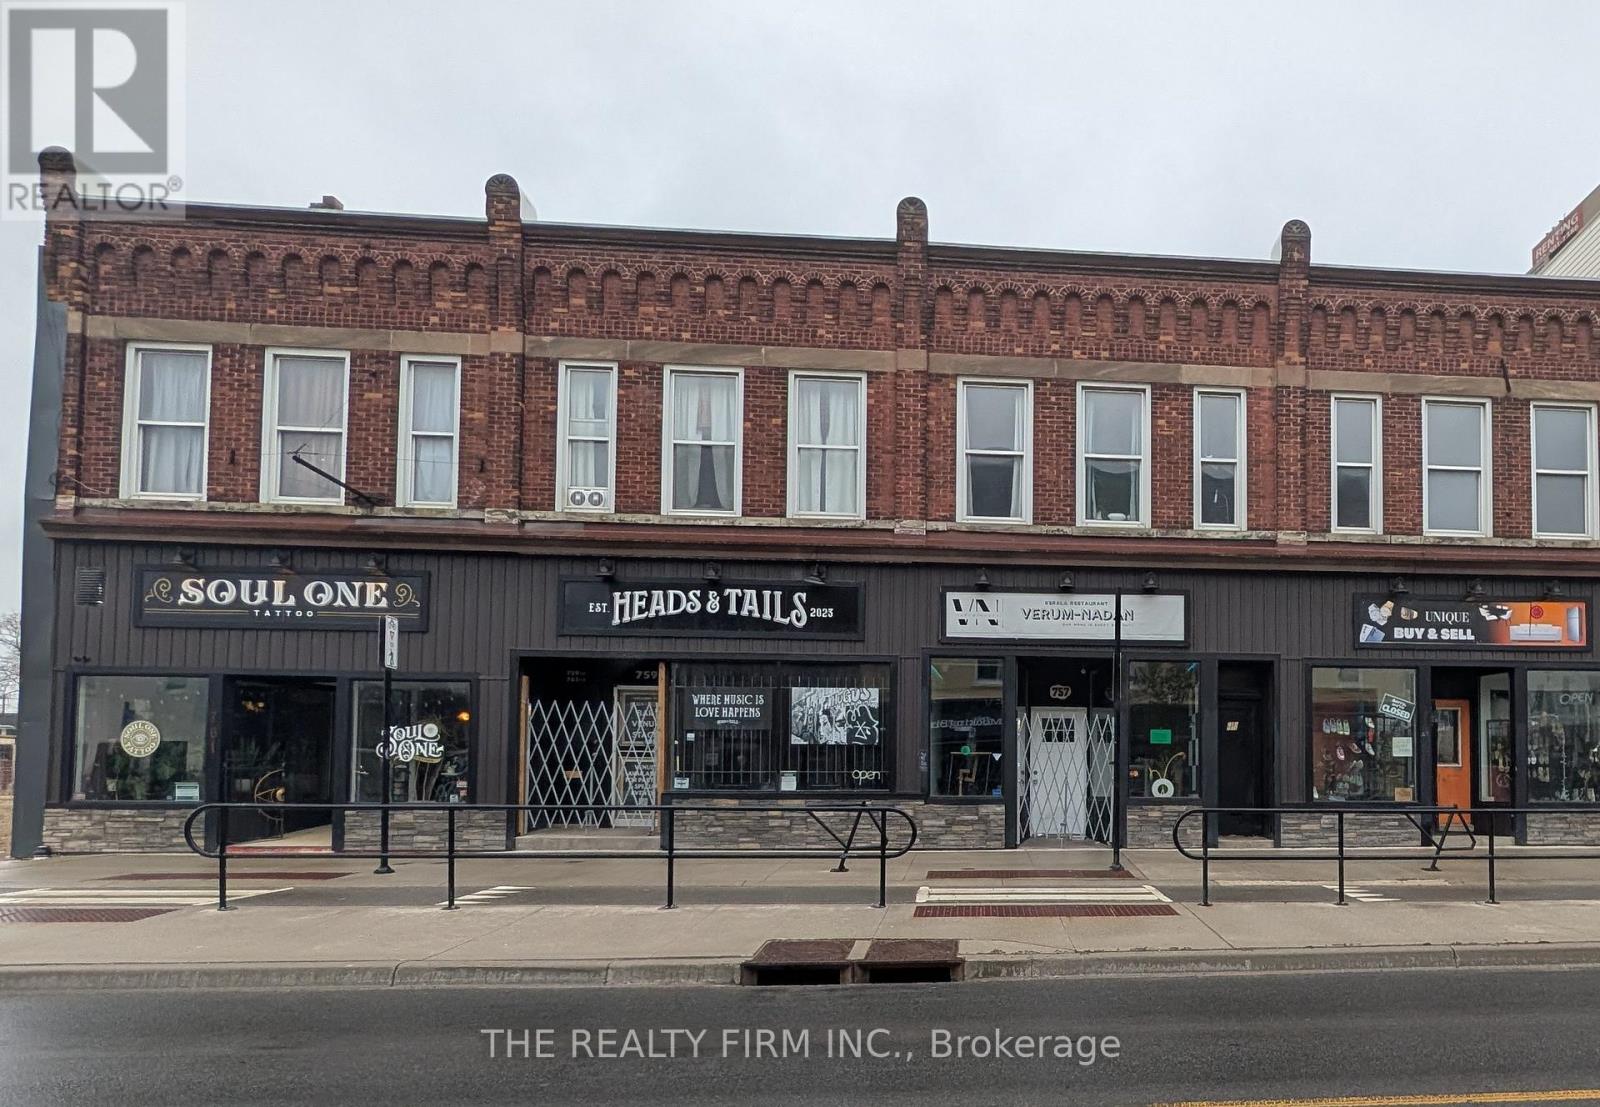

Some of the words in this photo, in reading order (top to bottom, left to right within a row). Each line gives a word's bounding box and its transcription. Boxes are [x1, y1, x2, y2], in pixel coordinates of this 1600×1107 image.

[178, 578, 296, 606] SOUL
[303, 580, 388, 608] ONE
[254, 609, 314, 618] TATTOO
[588, 602, 611, 614] EST.
[611, 588, 701, 626] HEADS
[705, 591, 720, 614] &
[724, 588, 807, 628] TAILS
[810, 607, 834, 618] 2023
[1425, 611, 1470, 626] UNIQUE
[1394, 627, 1424, 640] BUY
[1427, 627, 1438, 640] &
[1441, 628, 1475, 641] SELL
[634, 670, 657, 679] 759
[1052, 687, 1070, 697] 757
[1560, 692, 1594, 705] OPEN
[692, 694, 722, 706] WHERE
[723, 694, 753, 705] MUSIC
[755, 694, 765, 705] IS
[695, 706, 720, 718] LOVE
[722, 707, 761, 718] HAPPENS
[1382, 703, 1411, 719] CLOSED
[376, 723, 441, 757] SOUL
[124, 741, 157, 755] TATTOO
[397, 739, 445, 763] ONE
[851, 769, 881, 786] open
